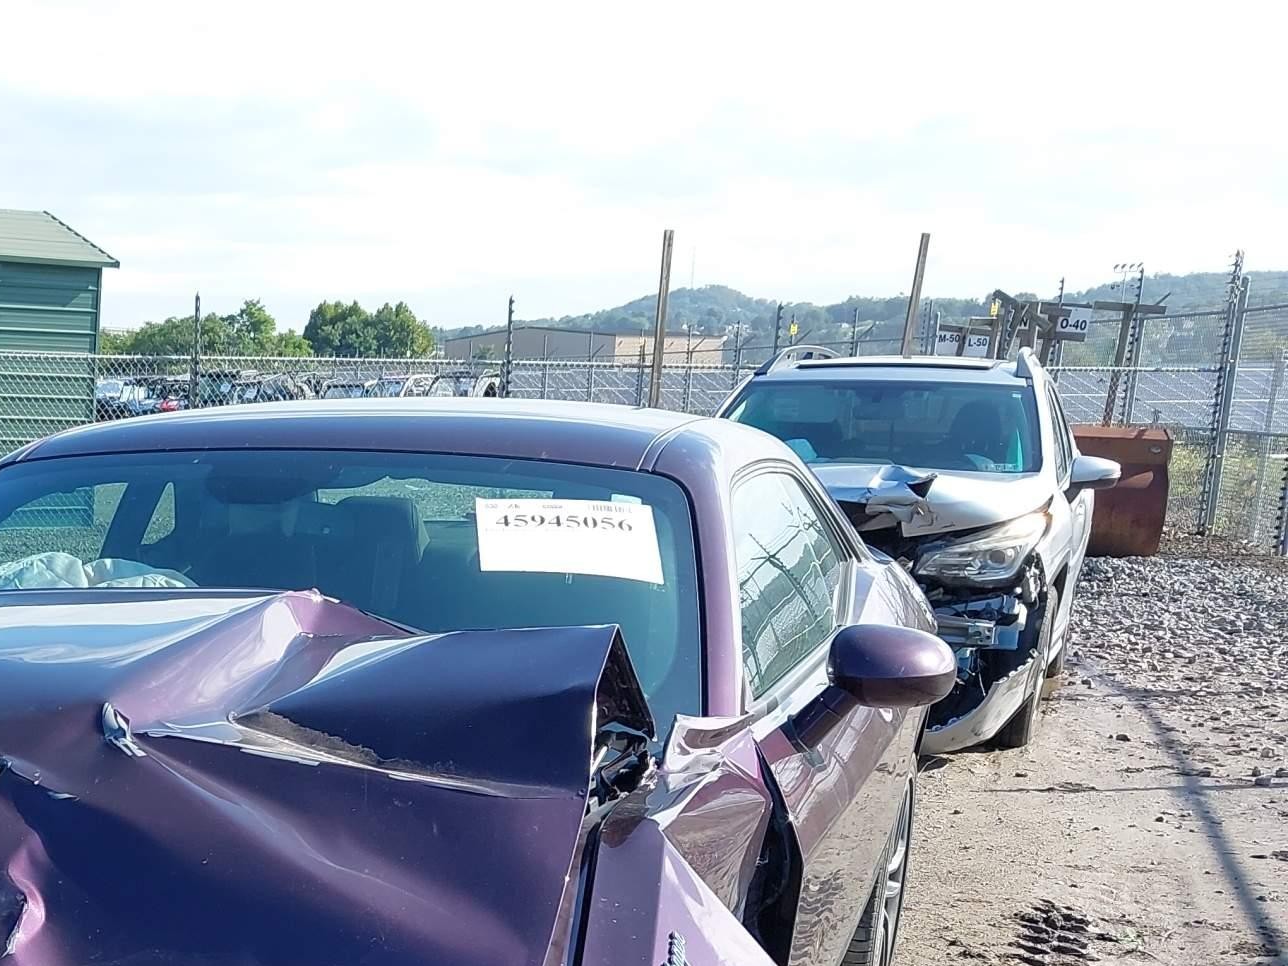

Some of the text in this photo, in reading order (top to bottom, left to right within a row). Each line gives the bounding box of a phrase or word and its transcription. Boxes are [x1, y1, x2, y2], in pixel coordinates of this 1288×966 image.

[1060, 318, 1087, 331] O-40
[938, 333, 960, 343] M-50
[968, 337, 988, 347] L-50
[495, 514, 633, 532] 45945056
